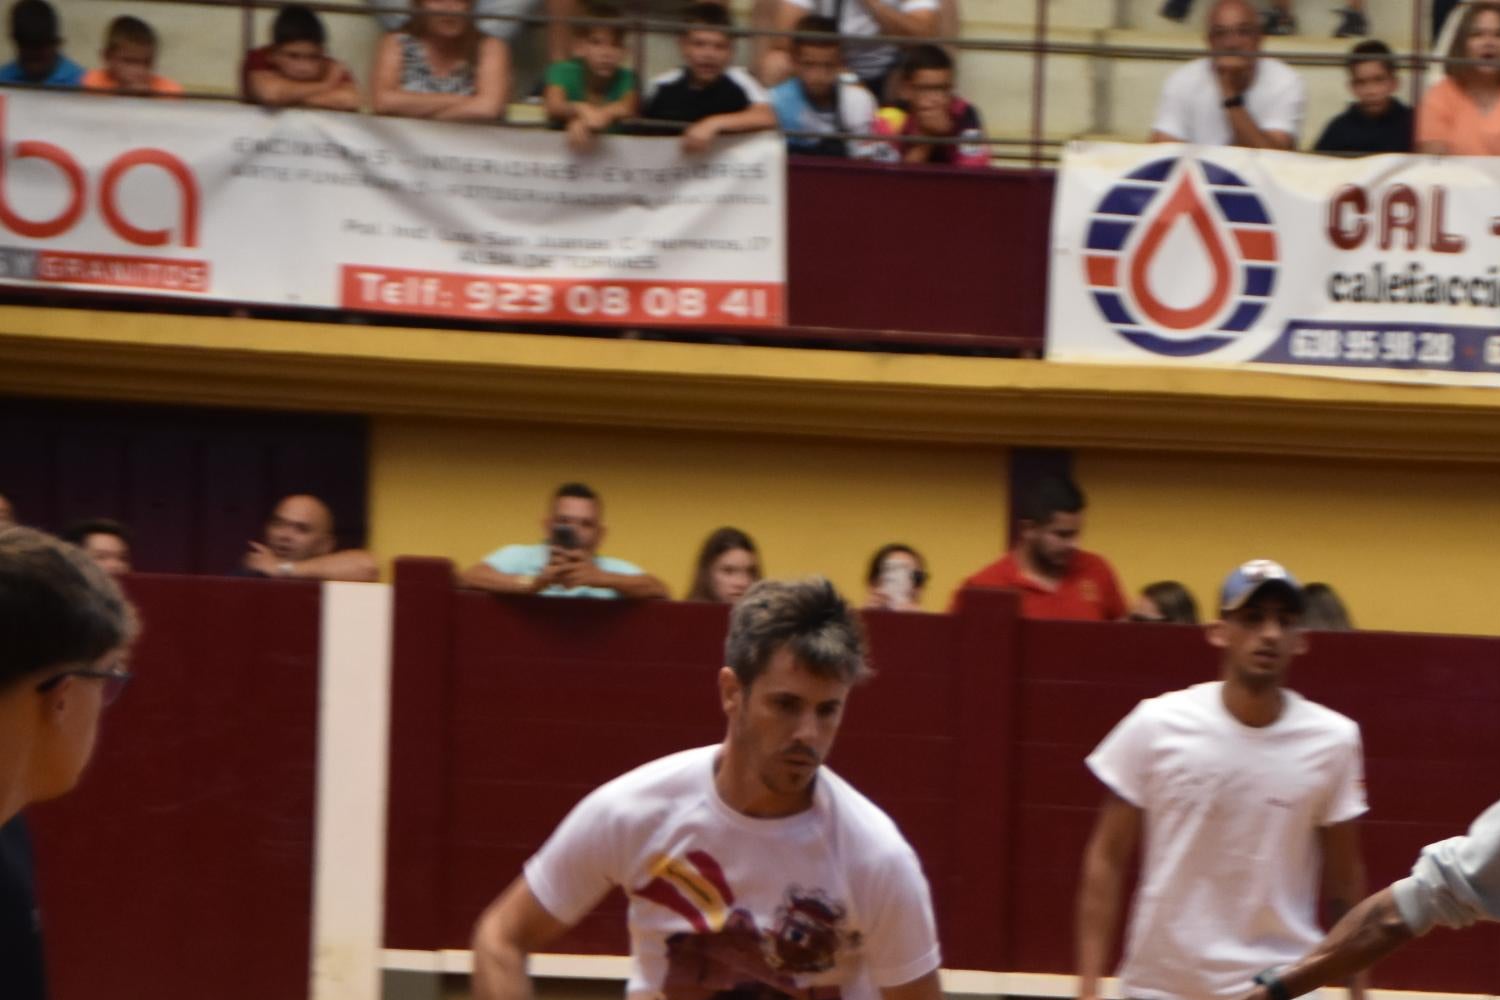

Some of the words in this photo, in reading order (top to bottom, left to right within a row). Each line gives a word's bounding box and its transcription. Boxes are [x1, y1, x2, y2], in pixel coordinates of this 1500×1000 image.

[1326, 183, 1467, 255] CAL
[354, 271, 453, 308] Telf:
[464, 280, 554, 313] 923
[565, 284, 632, 317] 08
[641, 285, 708, 318] 08
[717, 287, 769, 319] 41
